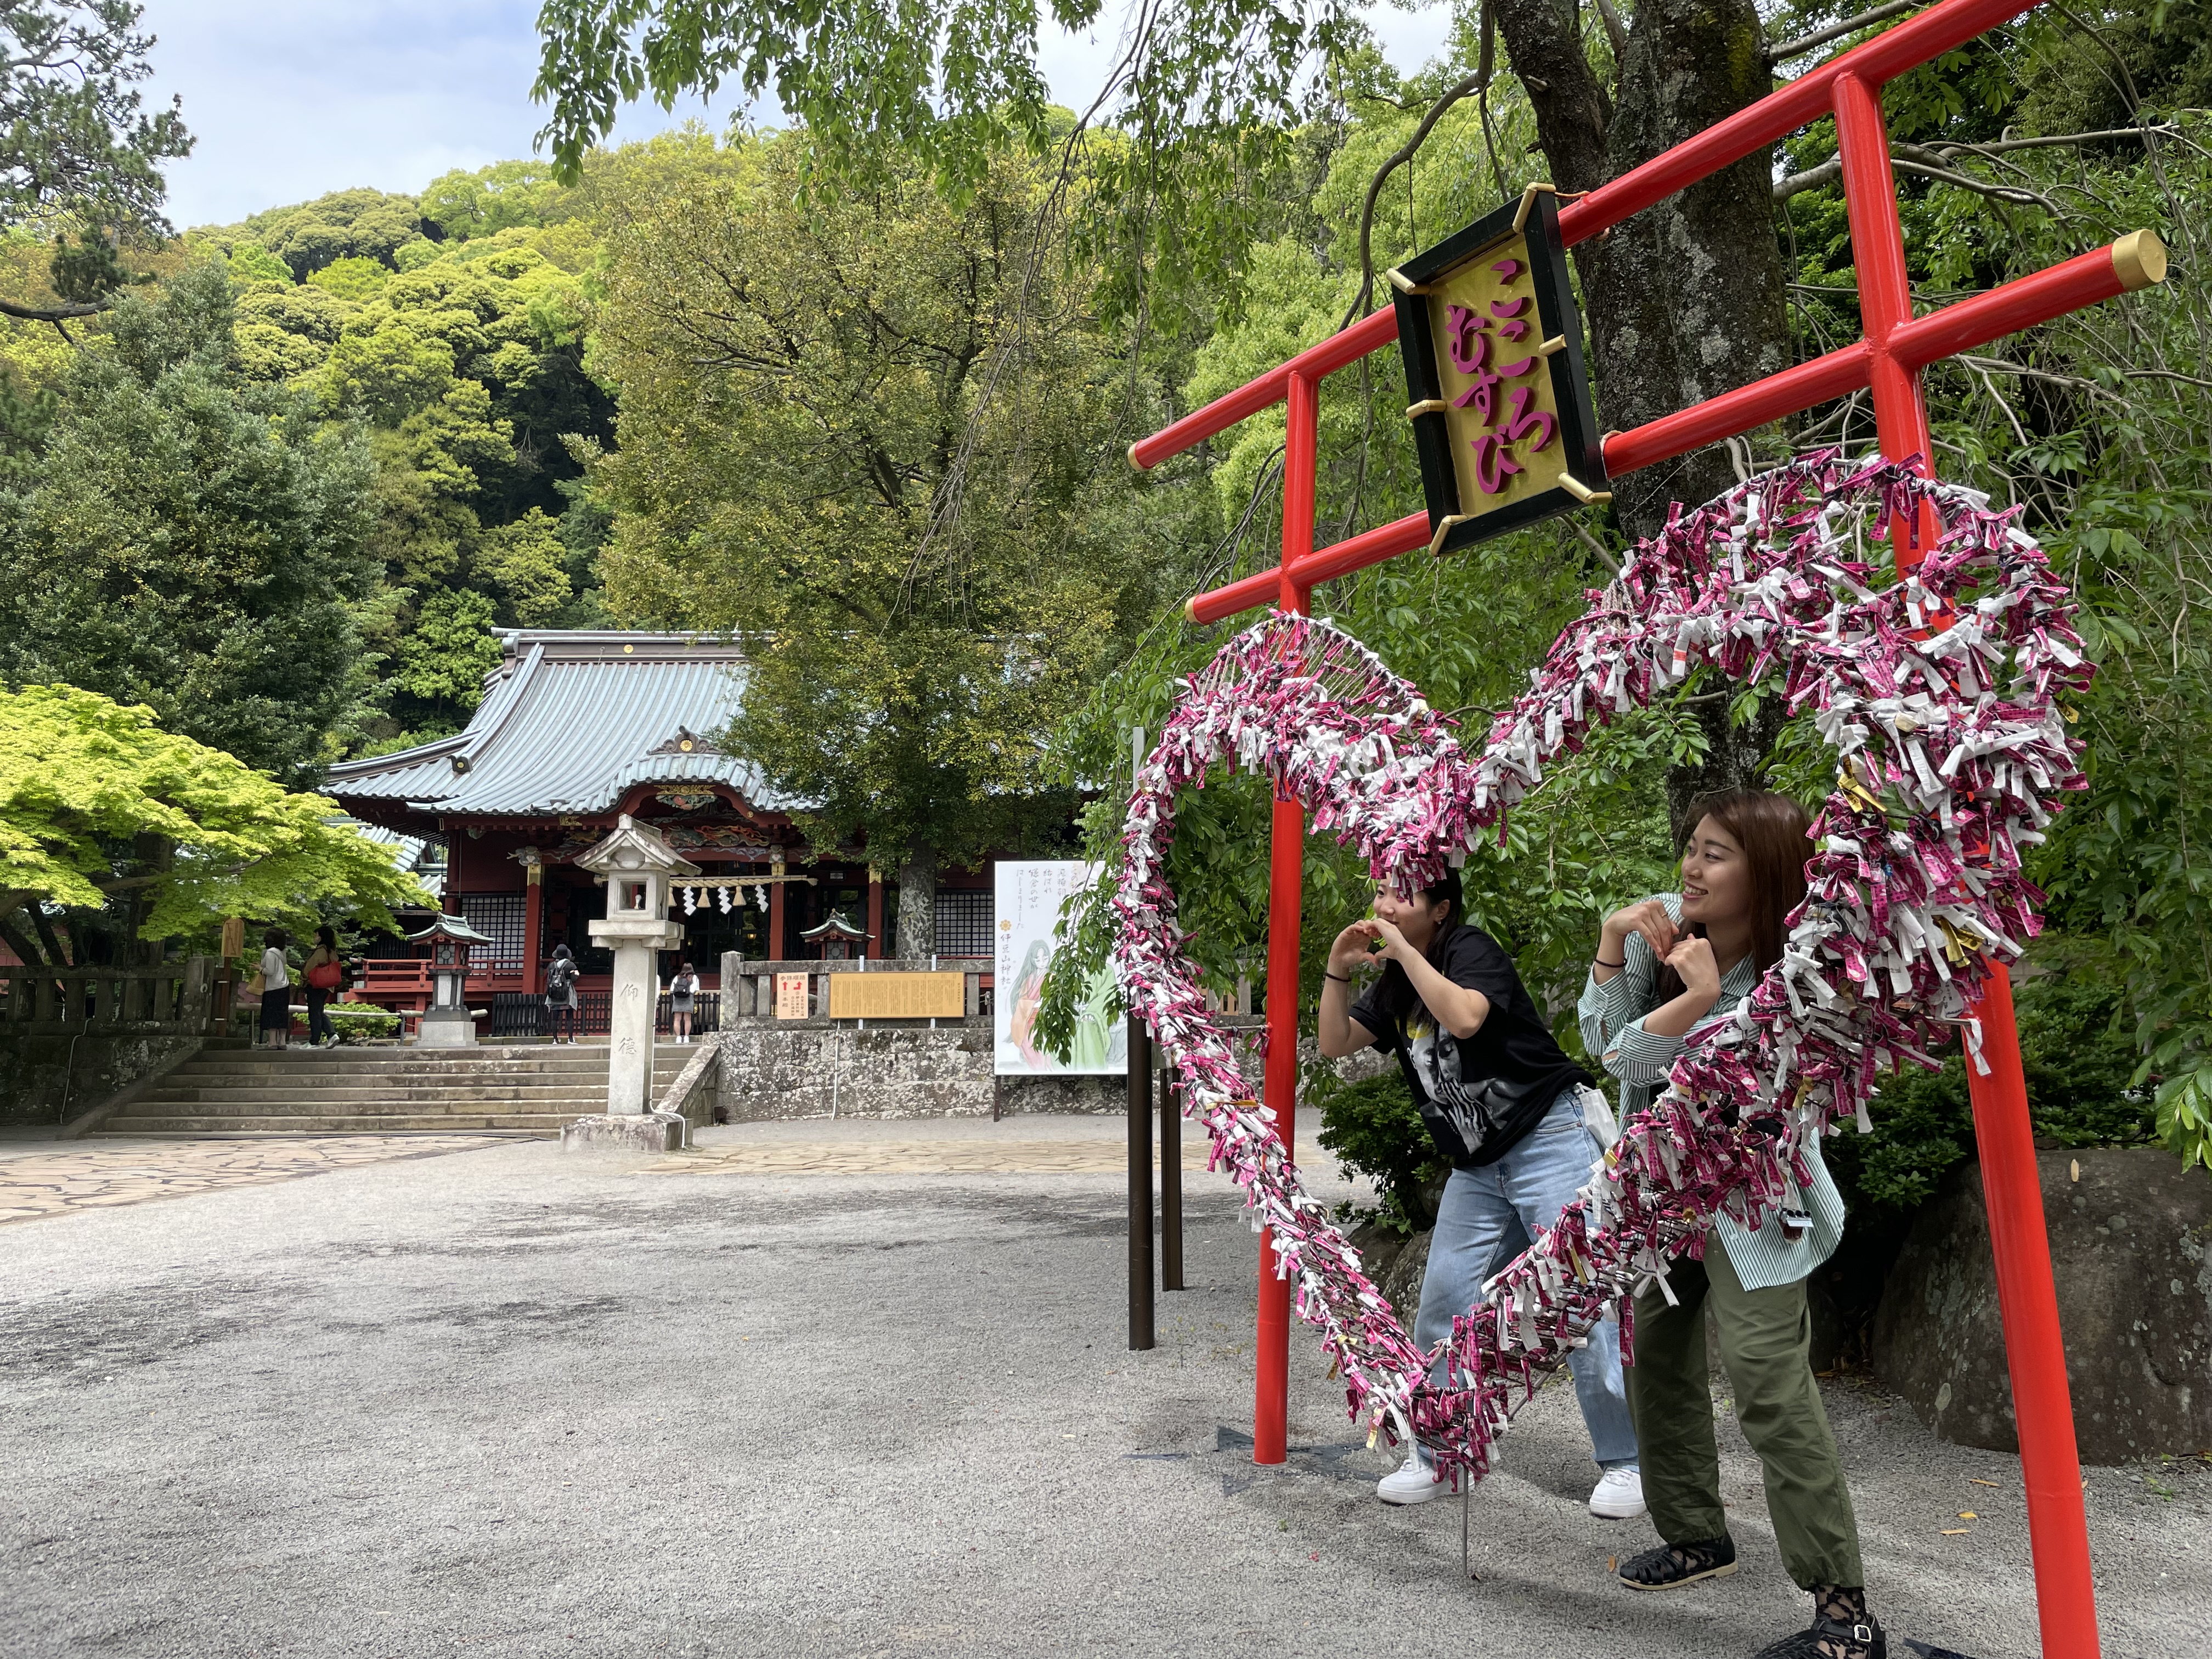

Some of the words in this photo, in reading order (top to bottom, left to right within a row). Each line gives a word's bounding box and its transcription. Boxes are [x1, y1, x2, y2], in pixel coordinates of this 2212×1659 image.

[1446, 304, 1524, 494] むすび
[1490, 259, 1557, 453] こころ
[1028, 868, 1040, 909] 鎌倉の世が
[1000, 934, 1012, 986] 伊豆山神社
